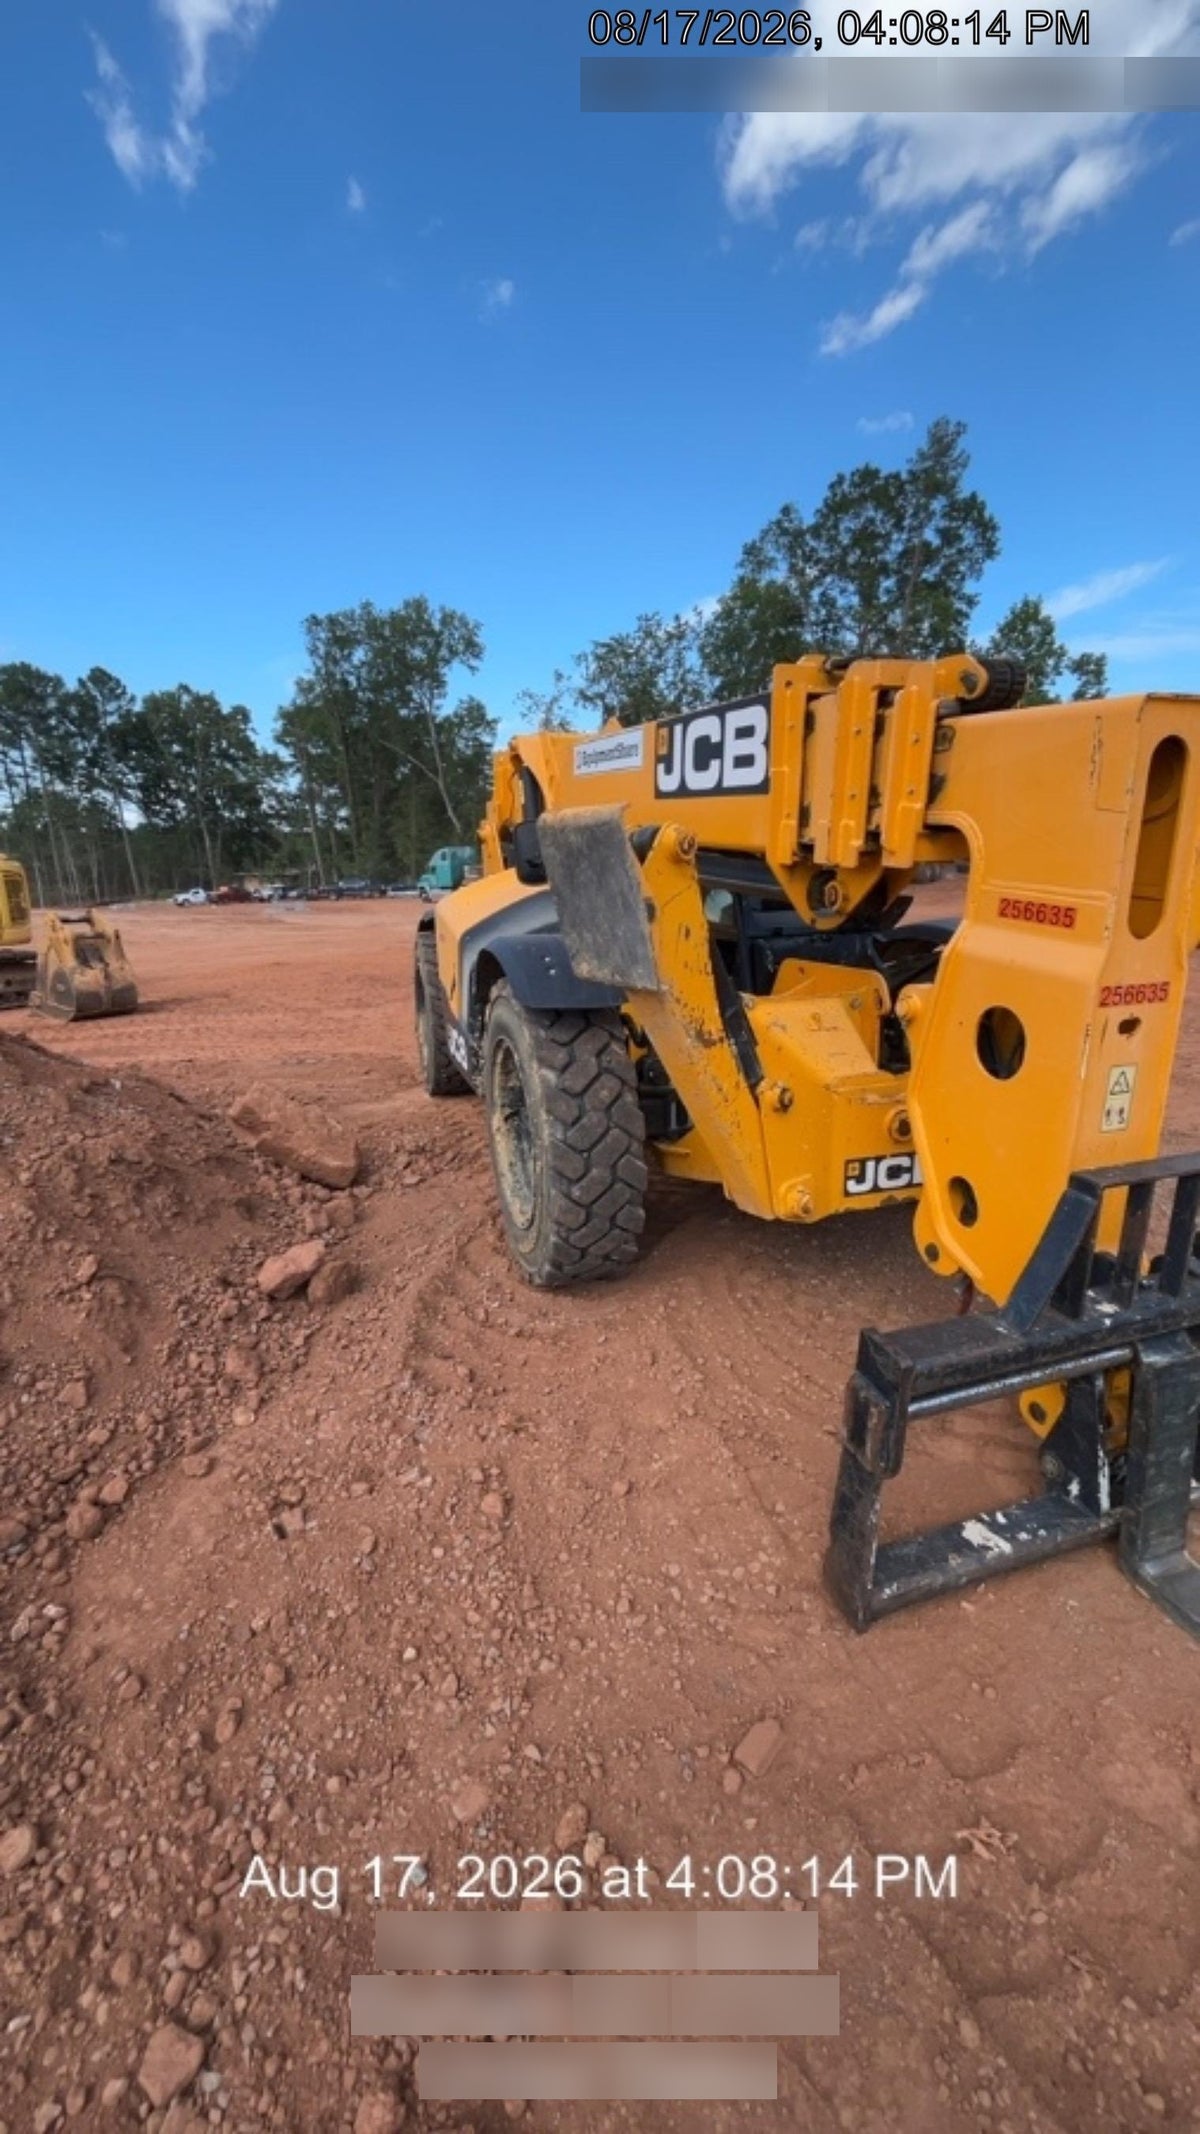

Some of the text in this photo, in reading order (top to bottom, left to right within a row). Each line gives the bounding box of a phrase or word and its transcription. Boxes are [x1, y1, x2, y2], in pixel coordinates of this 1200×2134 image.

[657, 705, 767, 792] JCB
[998, 898, 1076, 928] 256635
[1099, 981, 1170, 1008] 256635
[846, 1156, 922, 1193] JC
